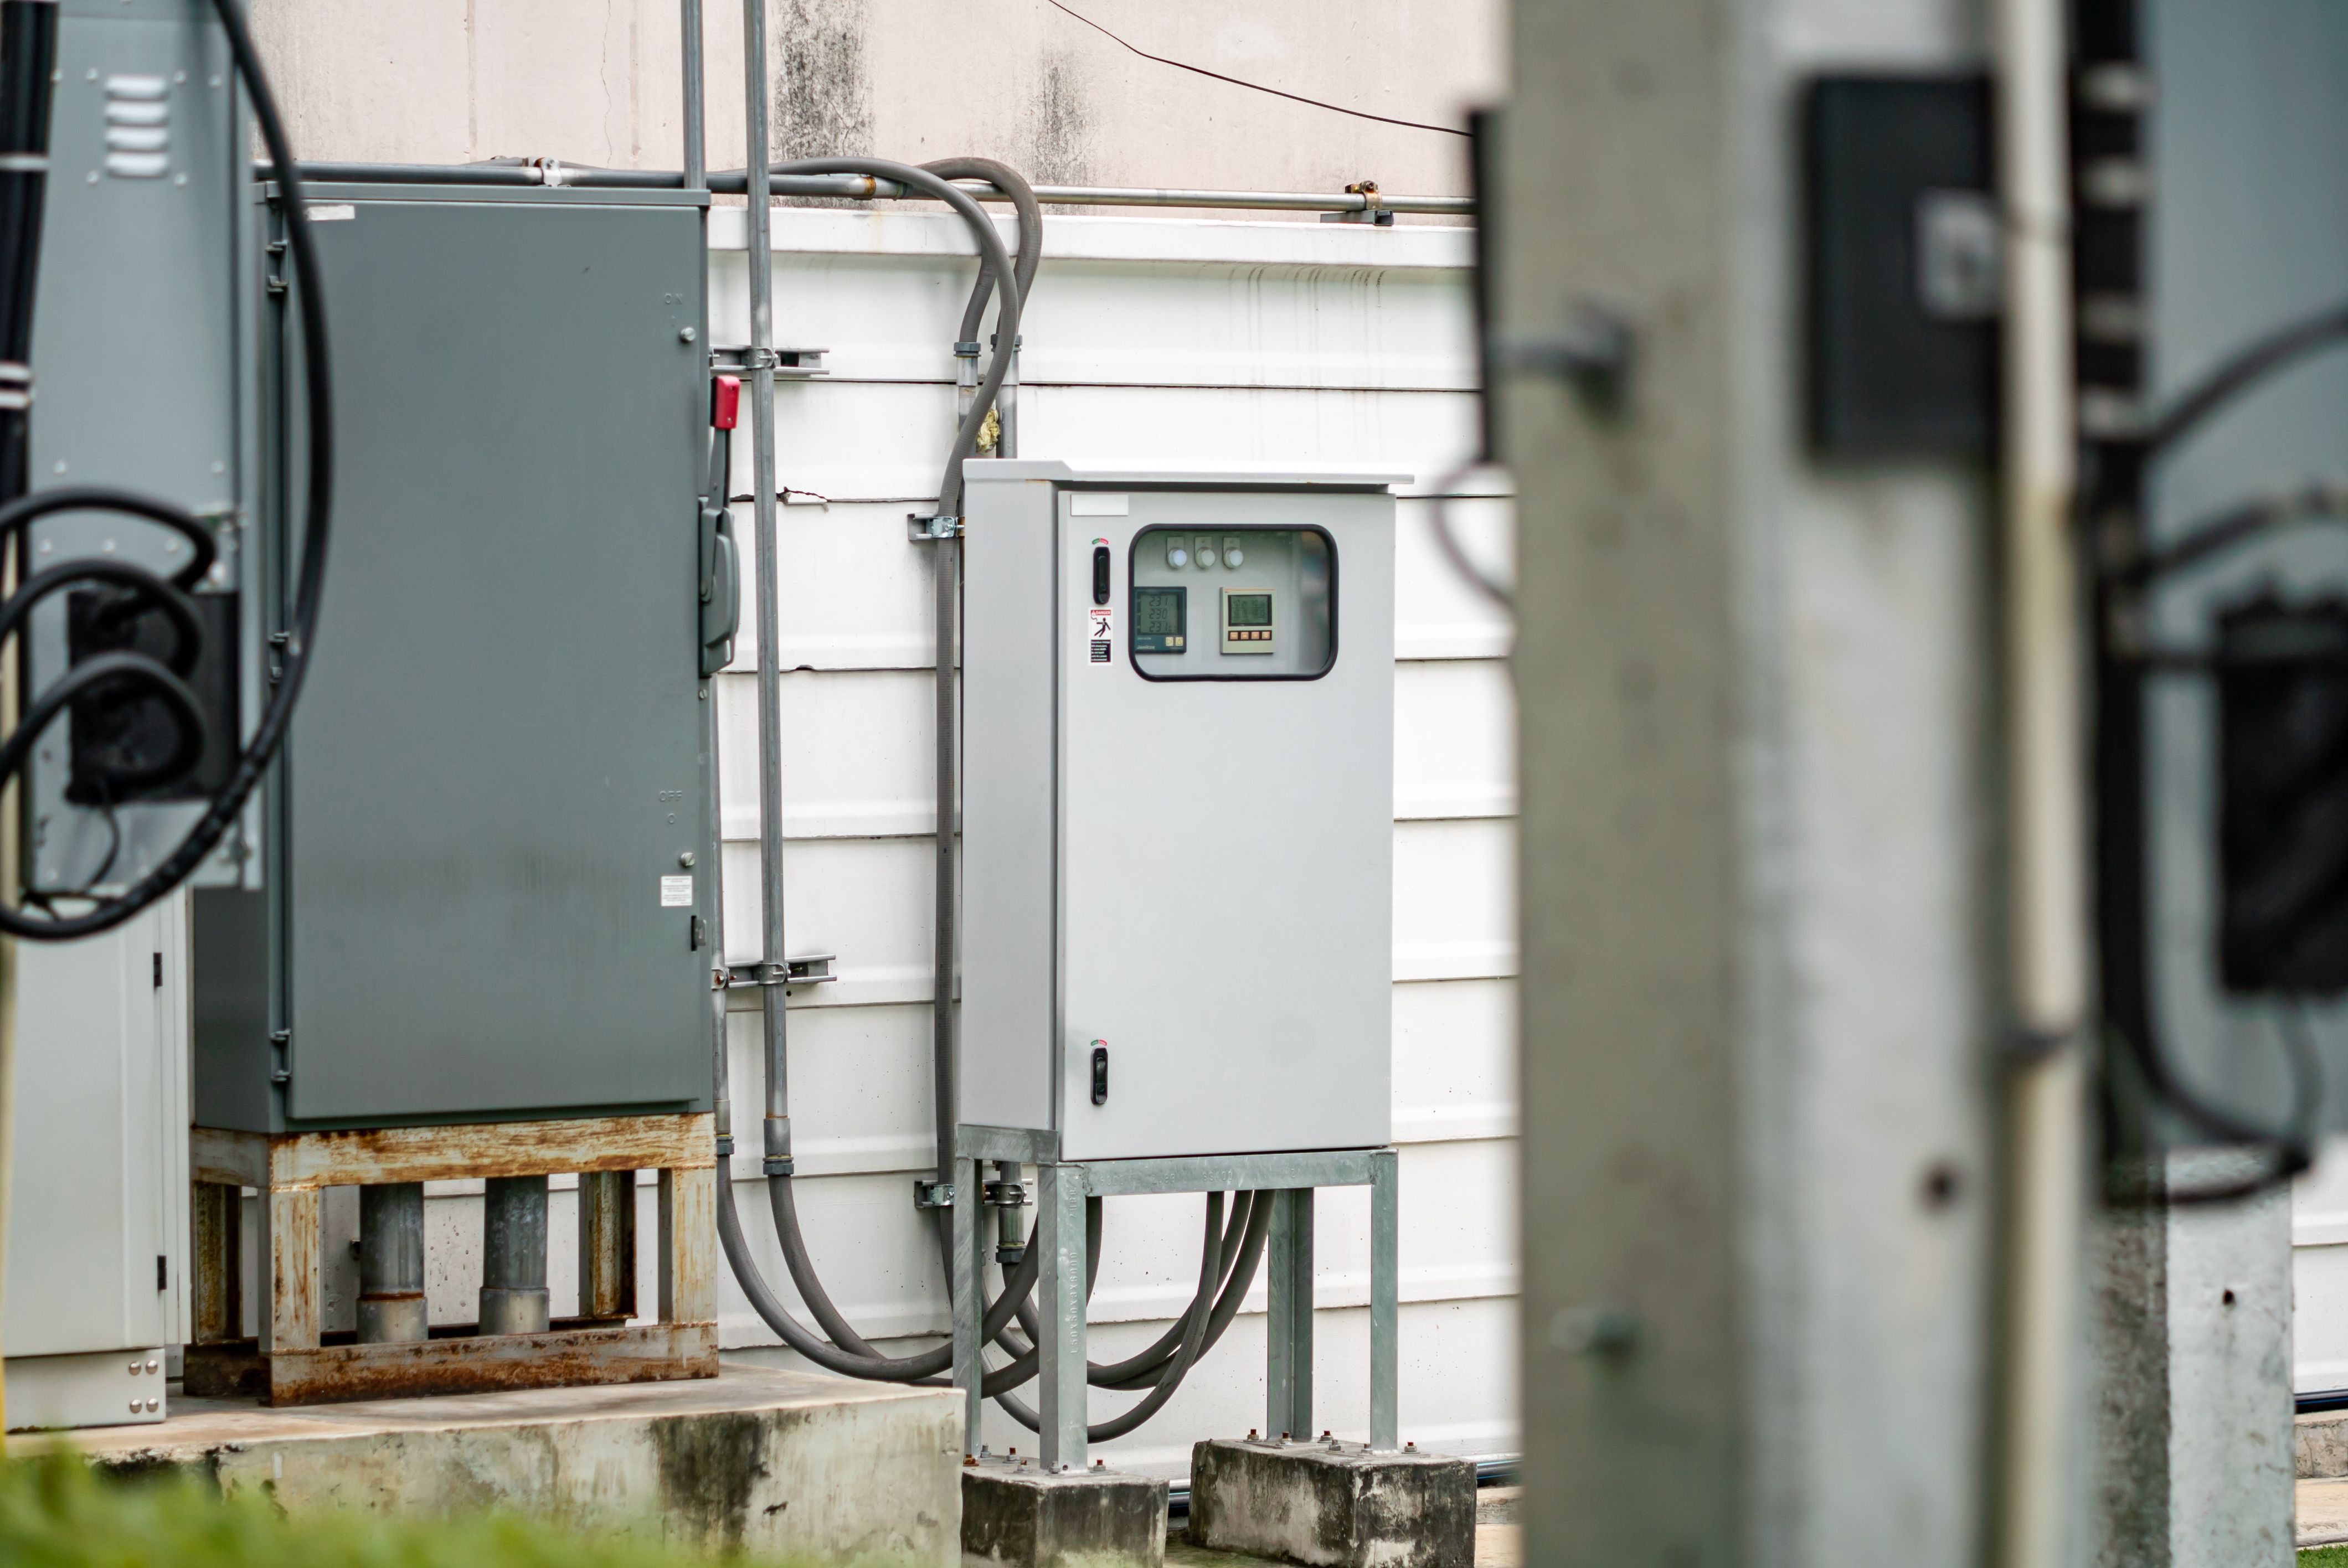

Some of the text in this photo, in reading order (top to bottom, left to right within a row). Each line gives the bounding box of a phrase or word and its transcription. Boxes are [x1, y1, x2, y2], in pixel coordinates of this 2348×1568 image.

[665, 292, 683, 305] ON
[1149, 596, 1168, 606] 231
[1149, 608, 1168, 620] 230
[1149, 621, 1168, 632] 231
[659, 791, 682, 802] OFF
